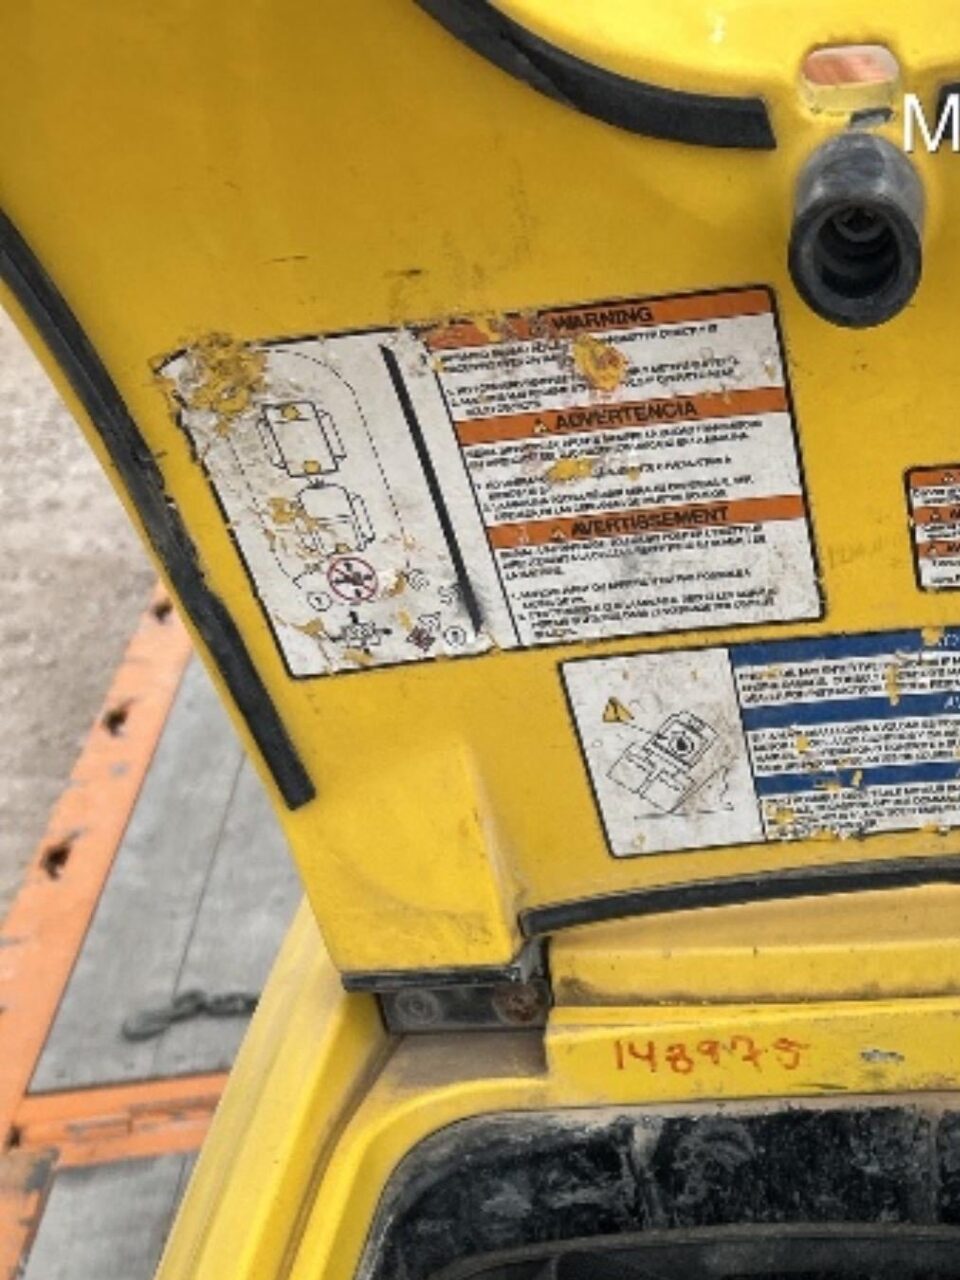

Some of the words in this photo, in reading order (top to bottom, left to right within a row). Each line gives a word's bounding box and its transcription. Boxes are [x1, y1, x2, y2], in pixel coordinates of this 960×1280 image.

[552, 307, 654, 330] WARNING
[555, 401, 698, 431] ADVERTENCIA
[571, 506, 729, 538] AVERTISSEMENT
